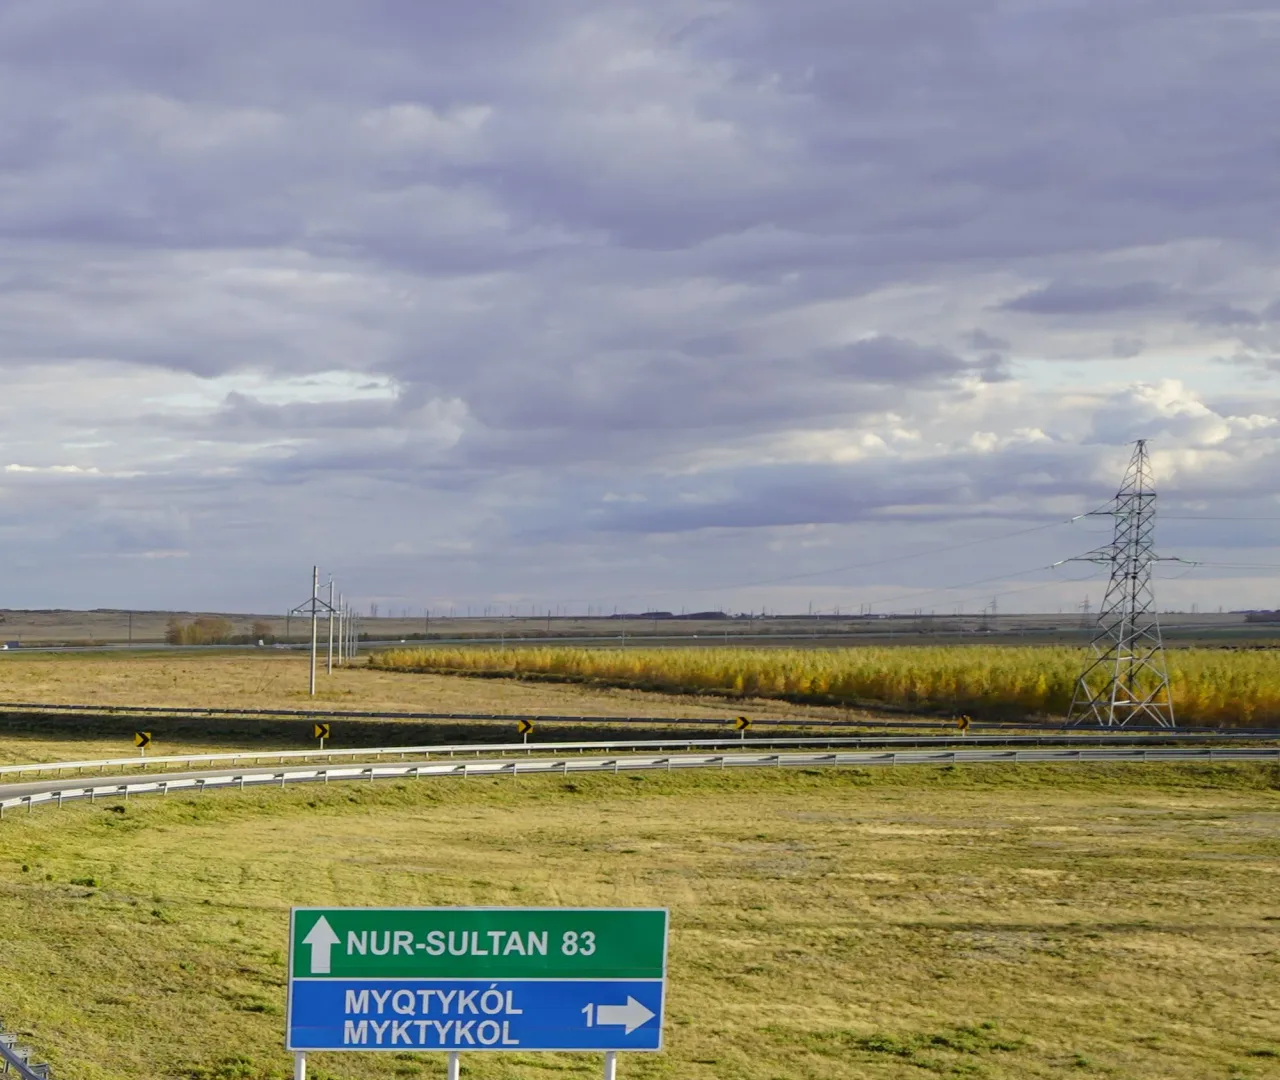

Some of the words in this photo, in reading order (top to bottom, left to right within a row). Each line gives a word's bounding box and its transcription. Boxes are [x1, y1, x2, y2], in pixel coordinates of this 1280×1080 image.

[346, 930, 549, 956] NUR-SULTAN
[561, 930, 597, 956] 83
[344, 983, 523, 1016] MYQTYKÓL
[580, 1002, 594, 1028] 1
[343, 1020, 520, 1045] MYKTYKOL
